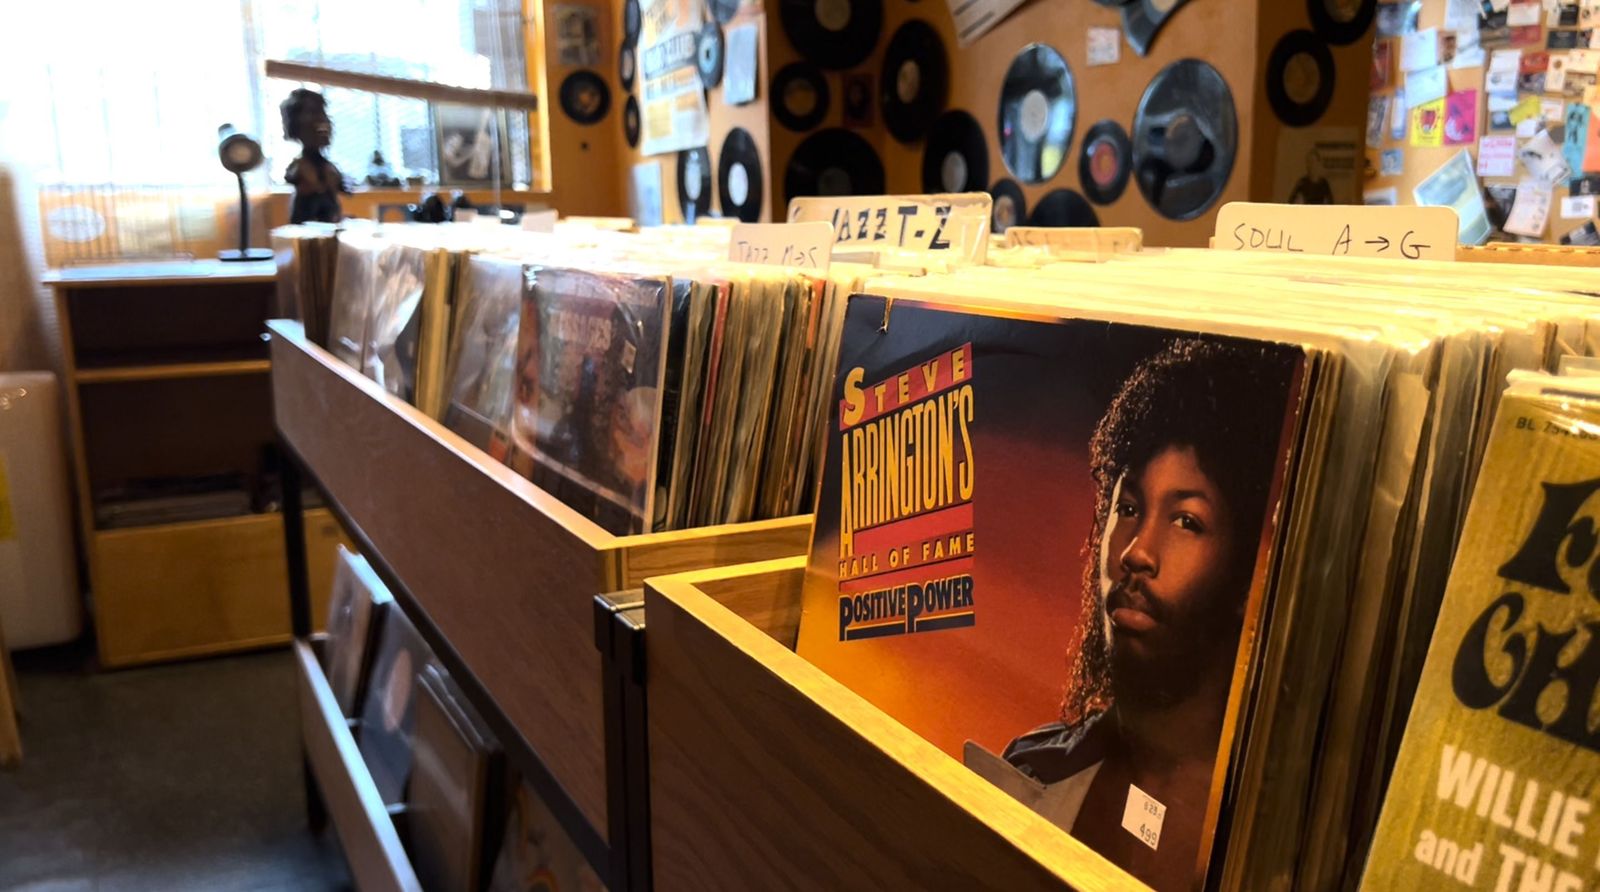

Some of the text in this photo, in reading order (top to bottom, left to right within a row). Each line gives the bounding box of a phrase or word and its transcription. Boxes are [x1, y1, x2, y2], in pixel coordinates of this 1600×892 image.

[898, 205, 952, 249] T-Z
[1233, 222, 1431, 260] SOUL A G
[843, 349, 965, 427] STEVE
[1515, 416, 1536, 431] BL
[839, 384, 974, 560] ARRINGTON'S
[839, 532, 975, 578] HALL OF FAME
[839, 574, 974, 641] POSITIVE POWER
[1436, 743, 1592, 858] WILLIE
[1139, 823, 1158, 846] 499
[1413, 829, 1484, 887] and
